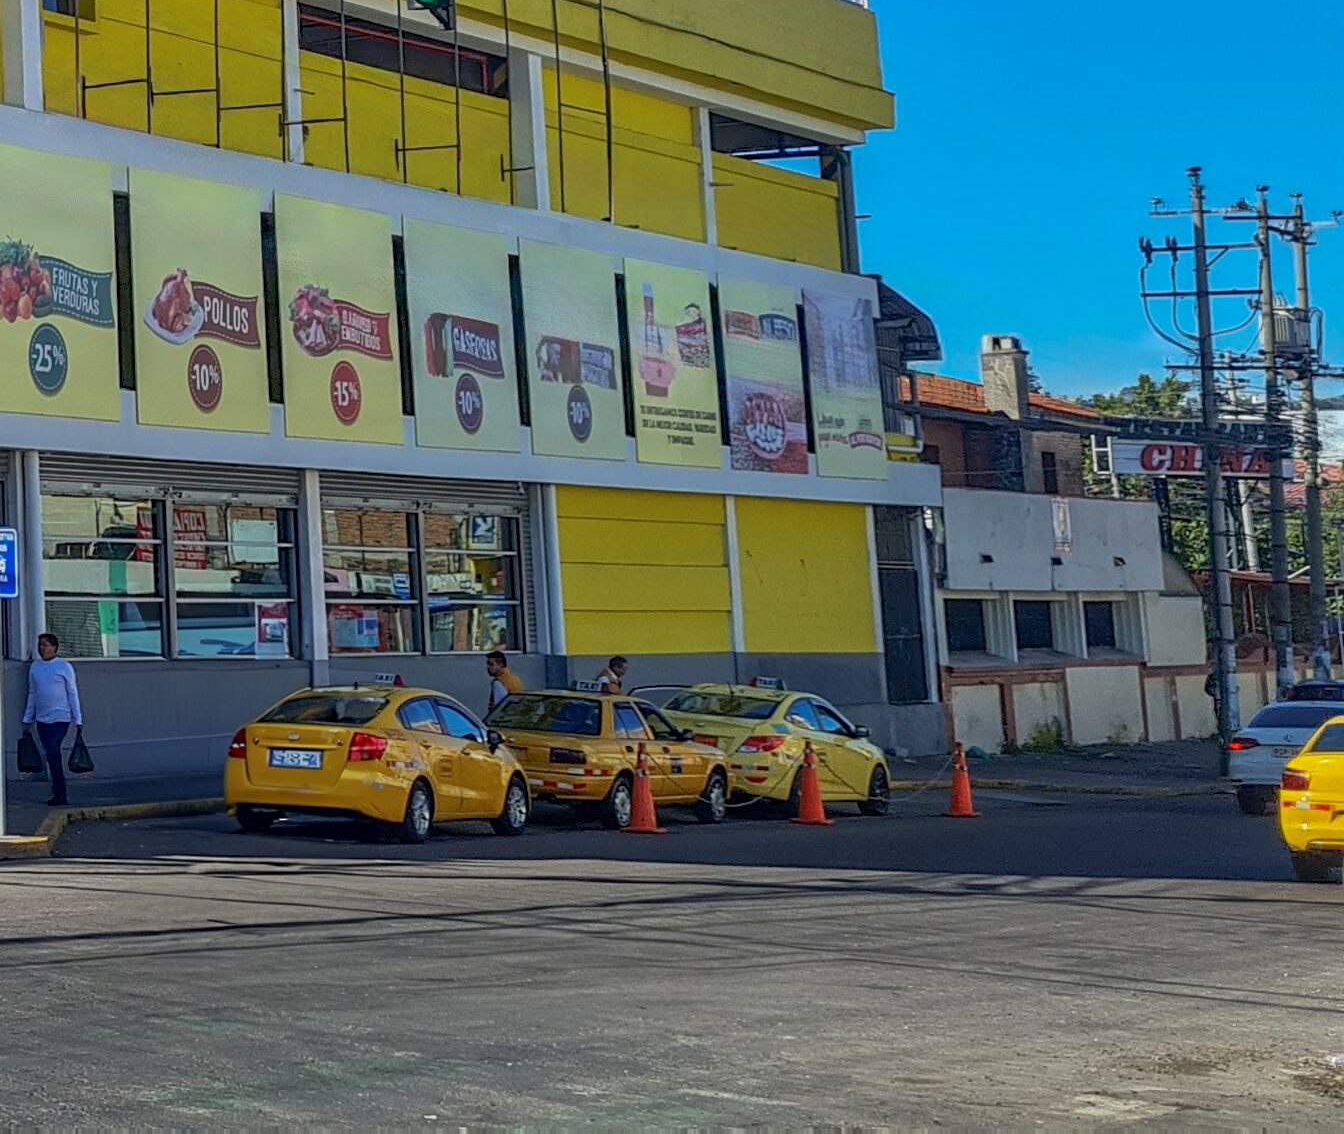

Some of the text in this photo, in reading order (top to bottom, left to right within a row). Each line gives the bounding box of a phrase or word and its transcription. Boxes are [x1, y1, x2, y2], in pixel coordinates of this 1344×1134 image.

[53, 267, 98, 297] FRUTAS Y
[52, 285, 100, 316] VERDURAS
[203, 295, 249, 334] POLLOS
[31, 343, 63, 373] -25%
[191, 363, 219, 391] -10%
[334, 380, 358, 407] -15%
[458, 390, 480, 415] -10%
[569, 401, 590, 424] -10%
[1141, 444, 1270, 472] CHNA
